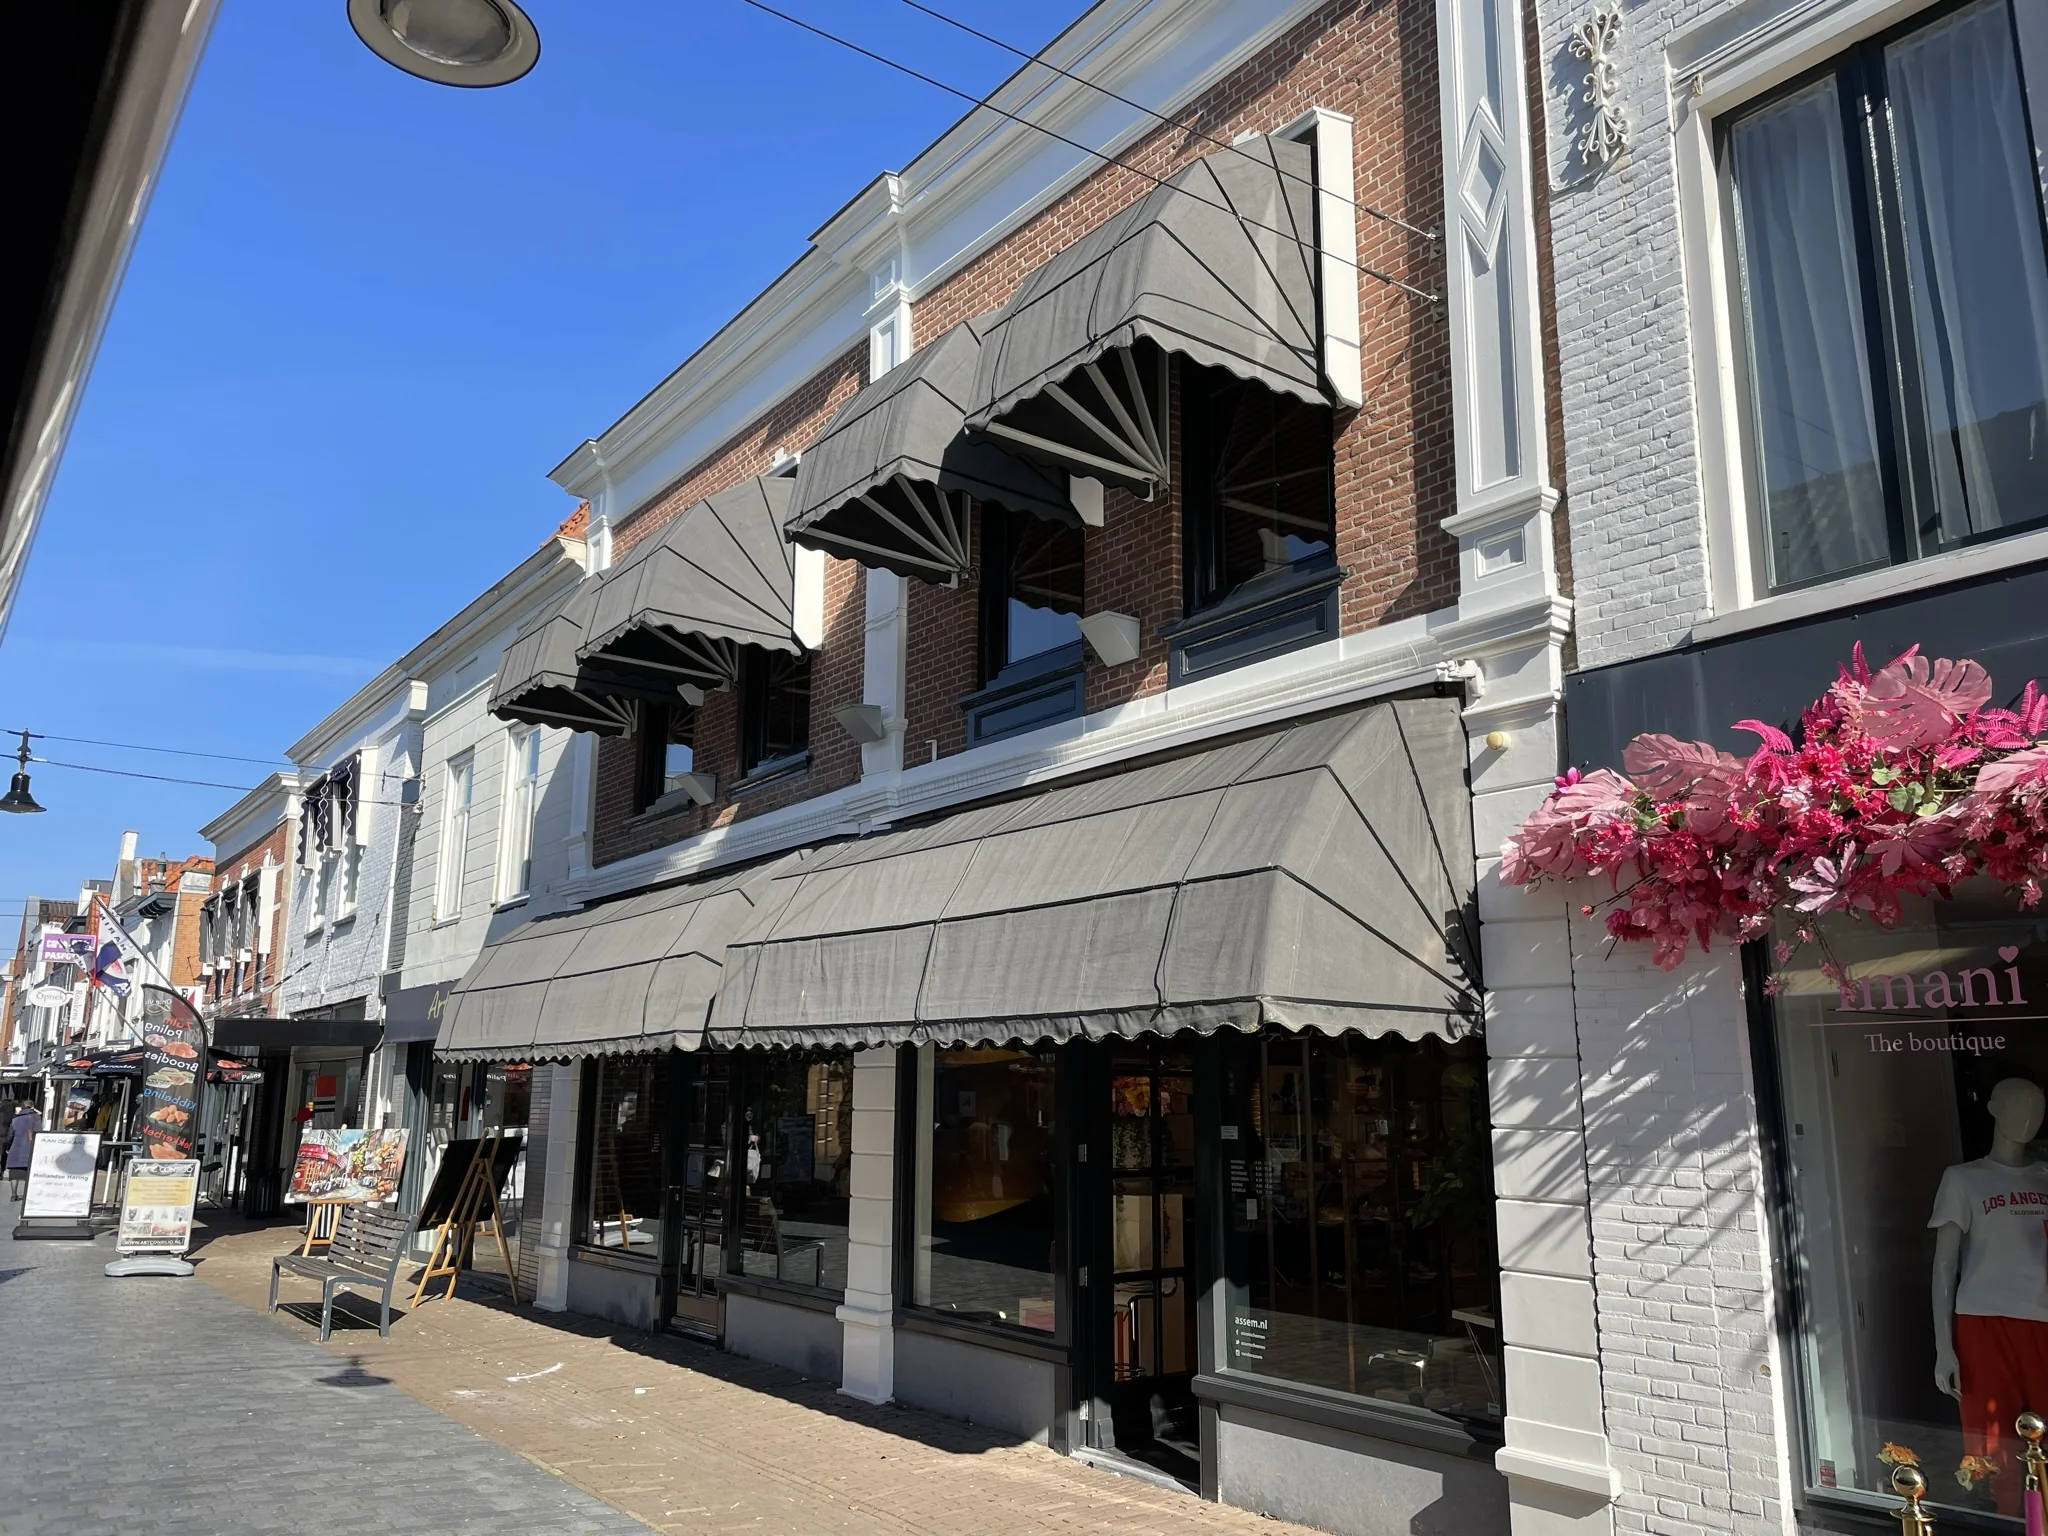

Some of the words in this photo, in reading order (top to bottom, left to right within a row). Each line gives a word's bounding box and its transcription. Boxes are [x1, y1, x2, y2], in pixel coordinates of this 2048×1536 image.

[1864, 1033, 1903, 1052] The
[1908, 1032, 2007, 1056] boutique
[1982, 1194, 2006, 1215] LOS
[1234, 1316, 1268, 1330] assem.nl
